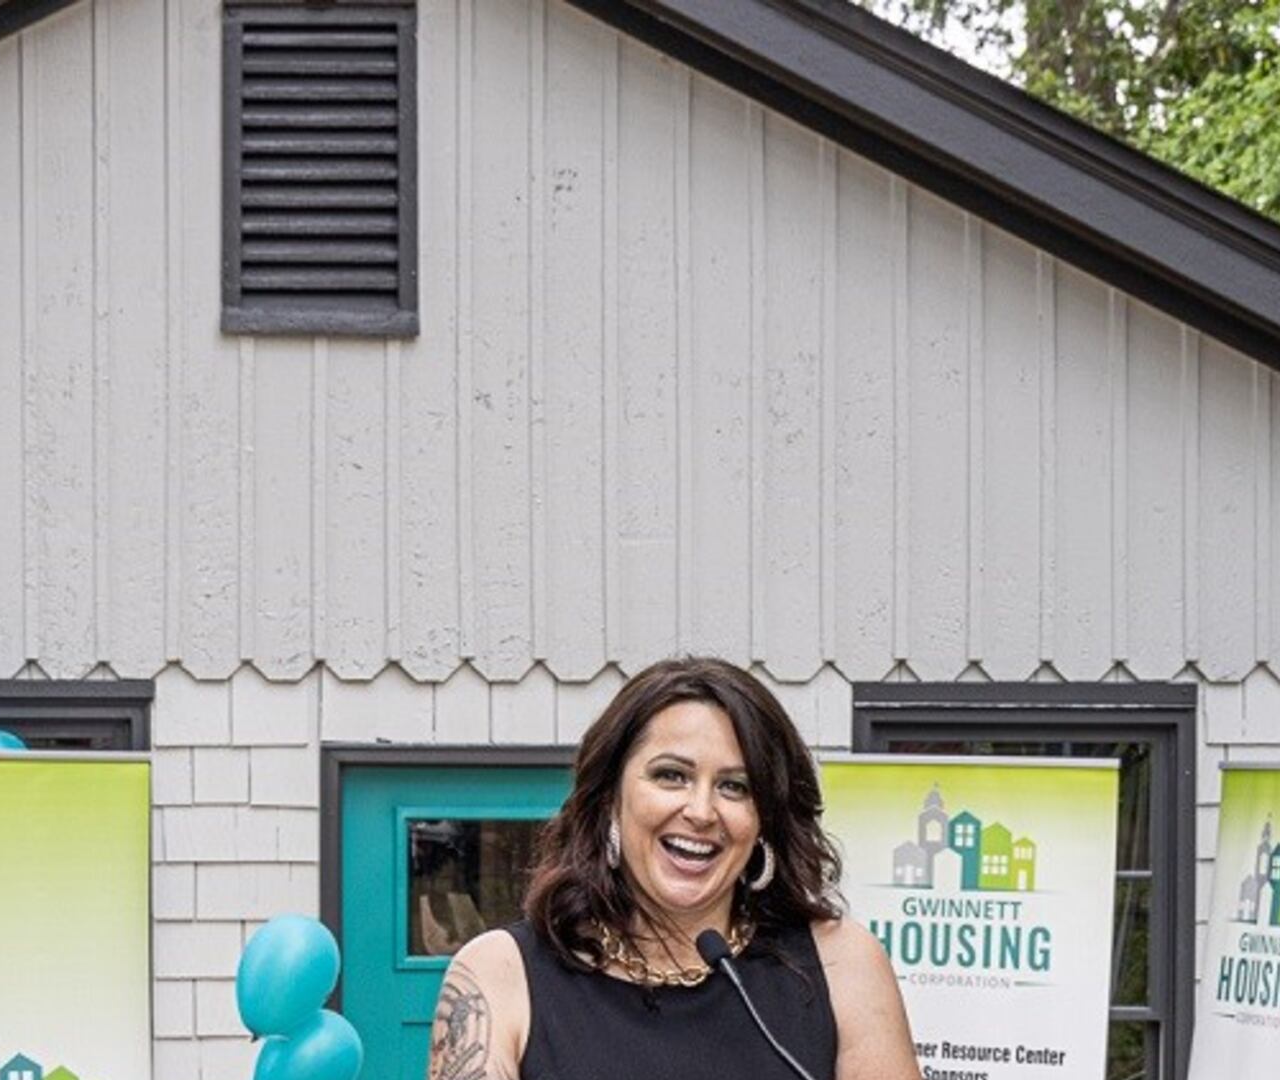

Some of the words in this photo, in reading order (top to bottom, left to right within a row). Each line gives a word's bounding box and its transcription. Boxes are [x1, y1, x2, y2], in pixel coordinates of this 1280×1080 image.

[902, 897, 1022, 920] GWINNETT
[869, 920, 1051, 971] HOUSING
[909, 973, 1012, 989] CORPORATION
[941, 1041, 1011, 1062] Resource
[1015, 1044, 1066, 1066] Center
